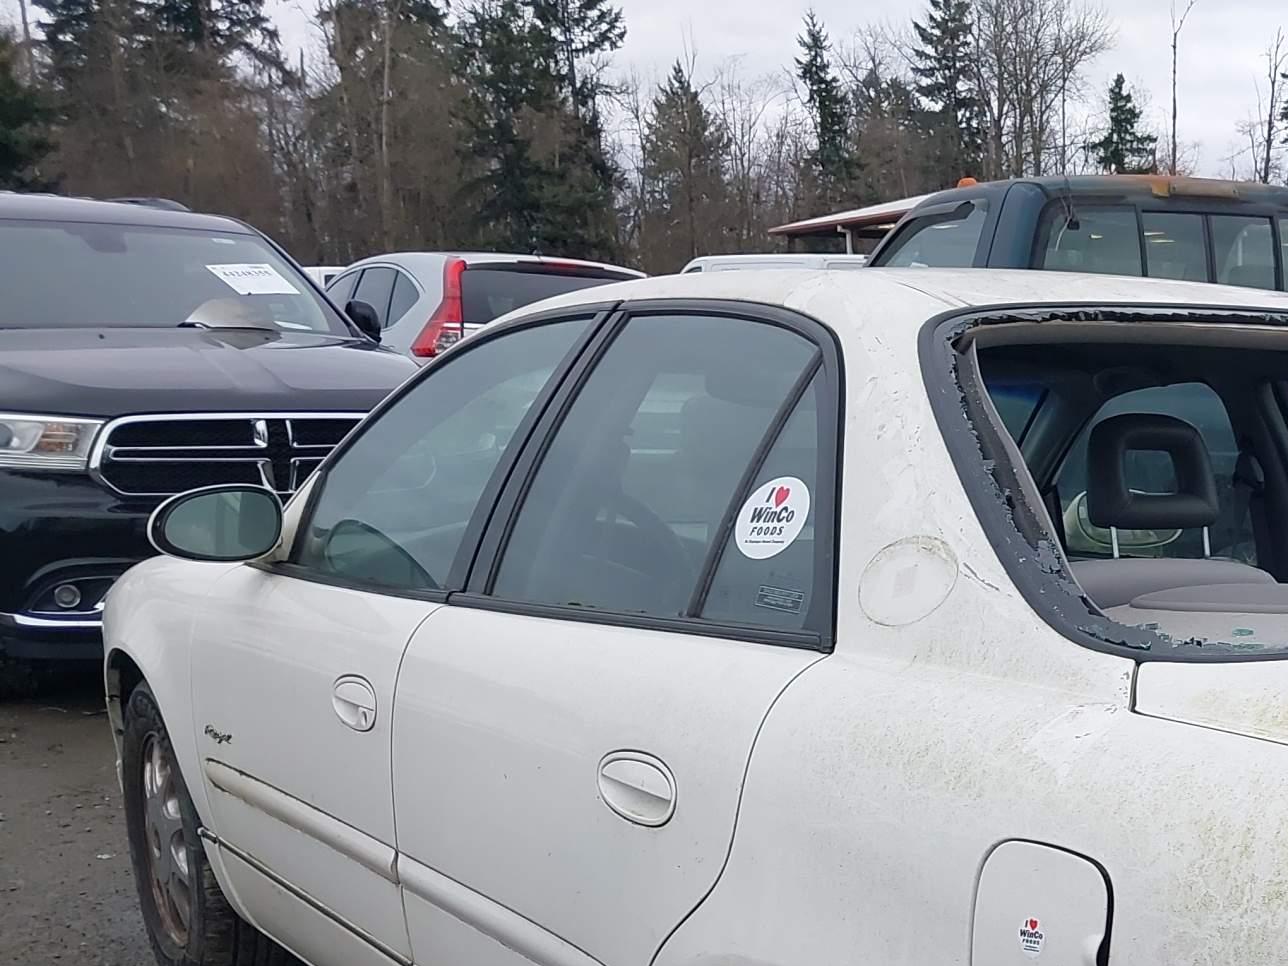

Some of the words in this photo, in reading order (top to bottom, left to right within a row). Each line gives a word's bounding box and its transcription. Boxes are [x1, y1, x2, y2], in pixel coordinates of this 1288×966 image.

[766, 487, 777, 503] I
[749, 505, 795, 523] WinCo
[749, 526, 785, 536] FOODS
[1019, 928, 1043, 940] WinCo
